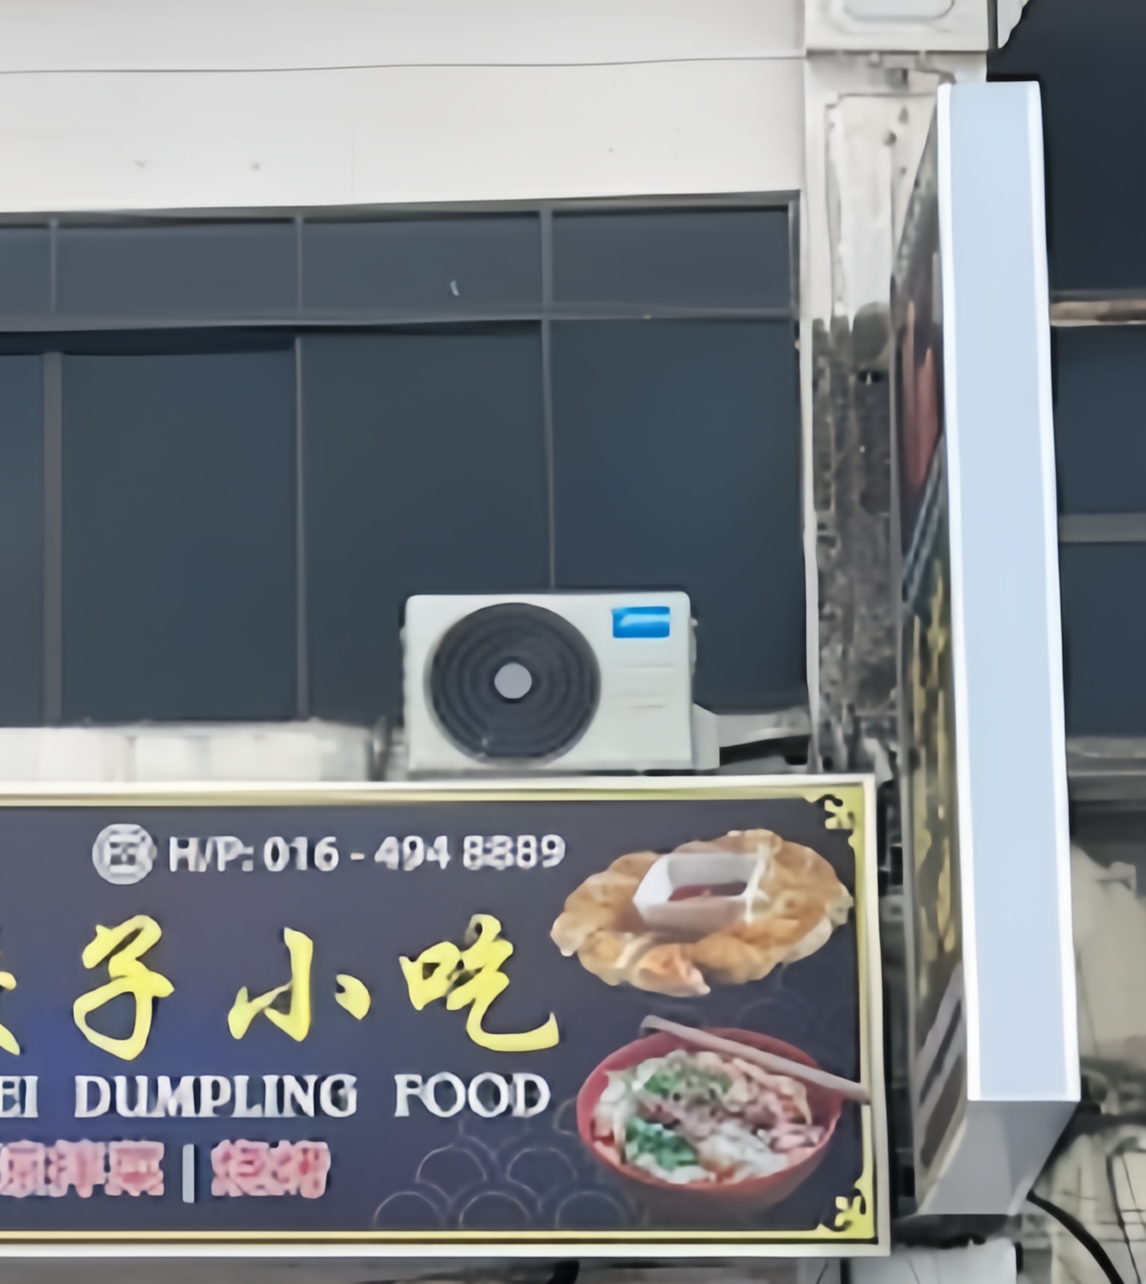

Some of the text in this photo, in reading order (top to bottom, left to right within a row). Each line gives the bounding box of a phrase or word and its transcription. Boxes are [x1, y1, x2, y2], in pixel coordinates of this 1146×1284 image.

[263, 835, 340, 872] 016
[374, 835, 451, 872] 494
[74, 1073, 357, 1117] DUMPLING
[393, 1071, 551, 1117] FOOD
